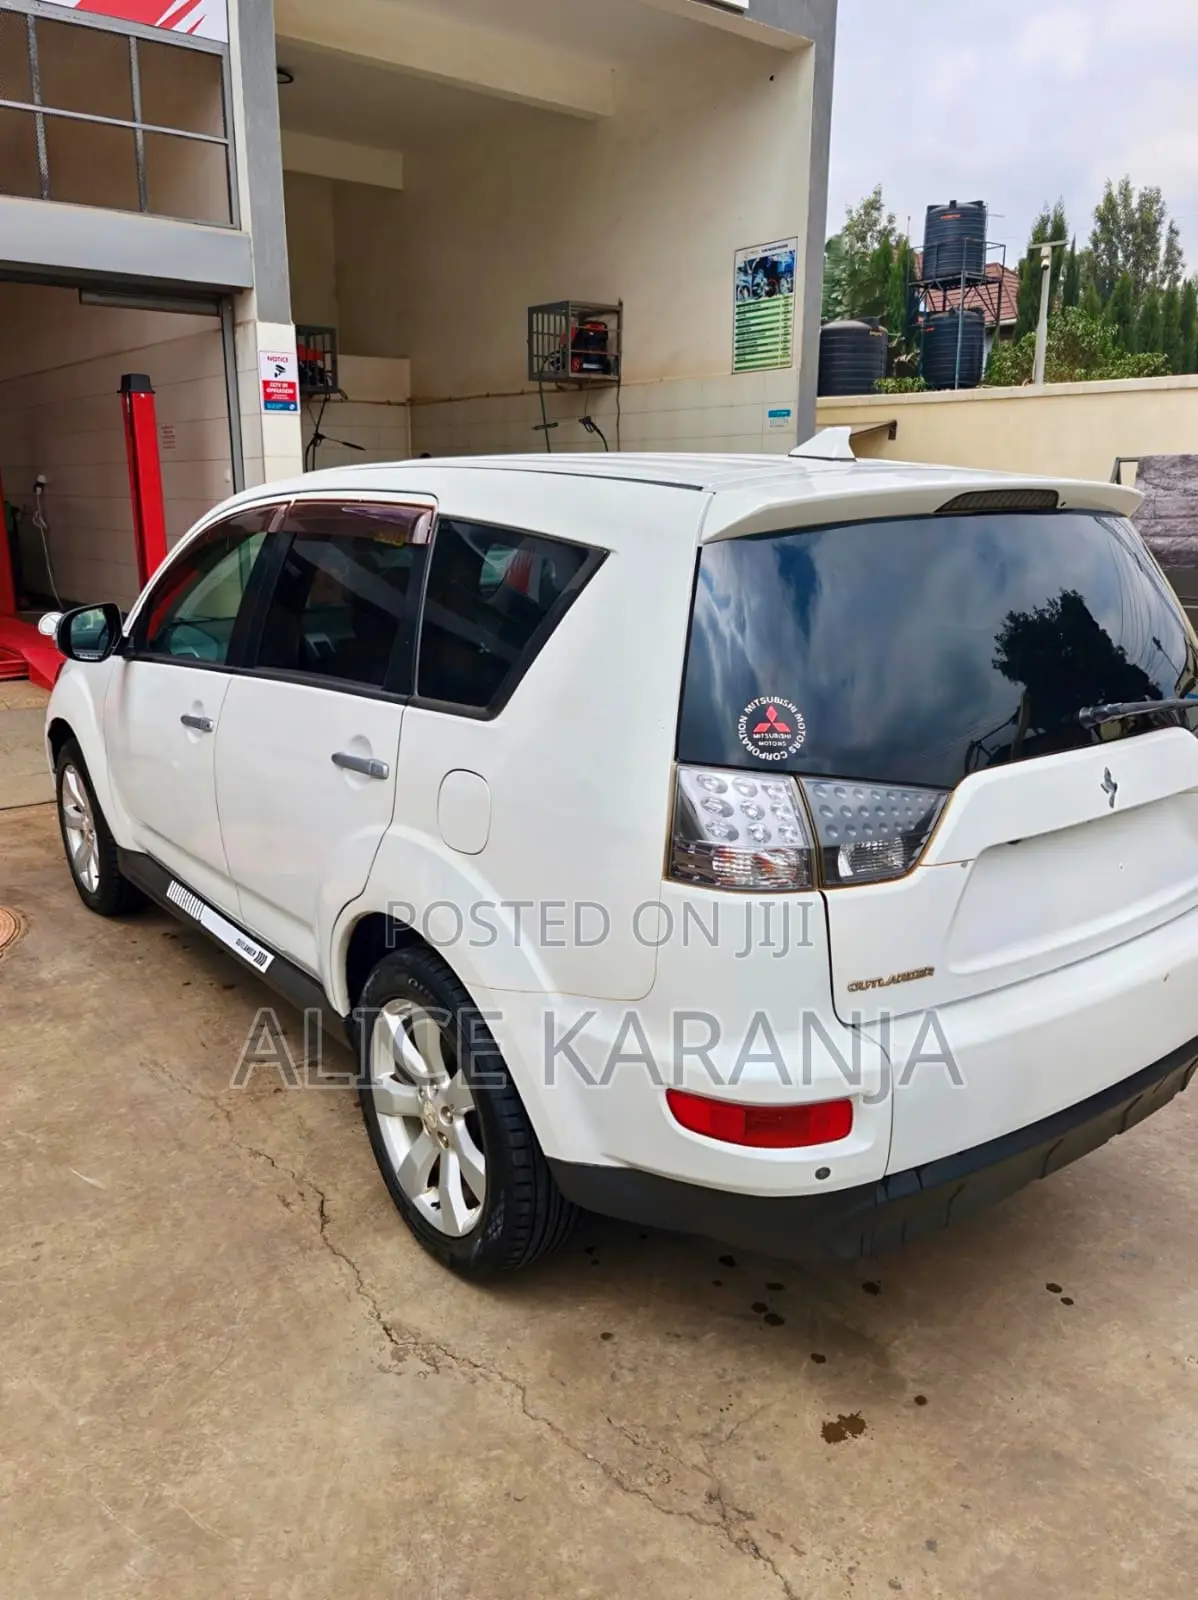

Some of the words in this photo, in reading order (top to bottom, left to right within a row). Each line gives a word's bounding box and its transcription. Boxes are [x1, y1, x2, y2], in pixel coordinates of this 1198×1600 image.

[744, 696, 798, 714] MITSUBISHI
[738, 715, 788, 760] CORPORATION
[788, 713, 806, 754] MOTORS
[847, 966, 935, 992] OUTLANDER
